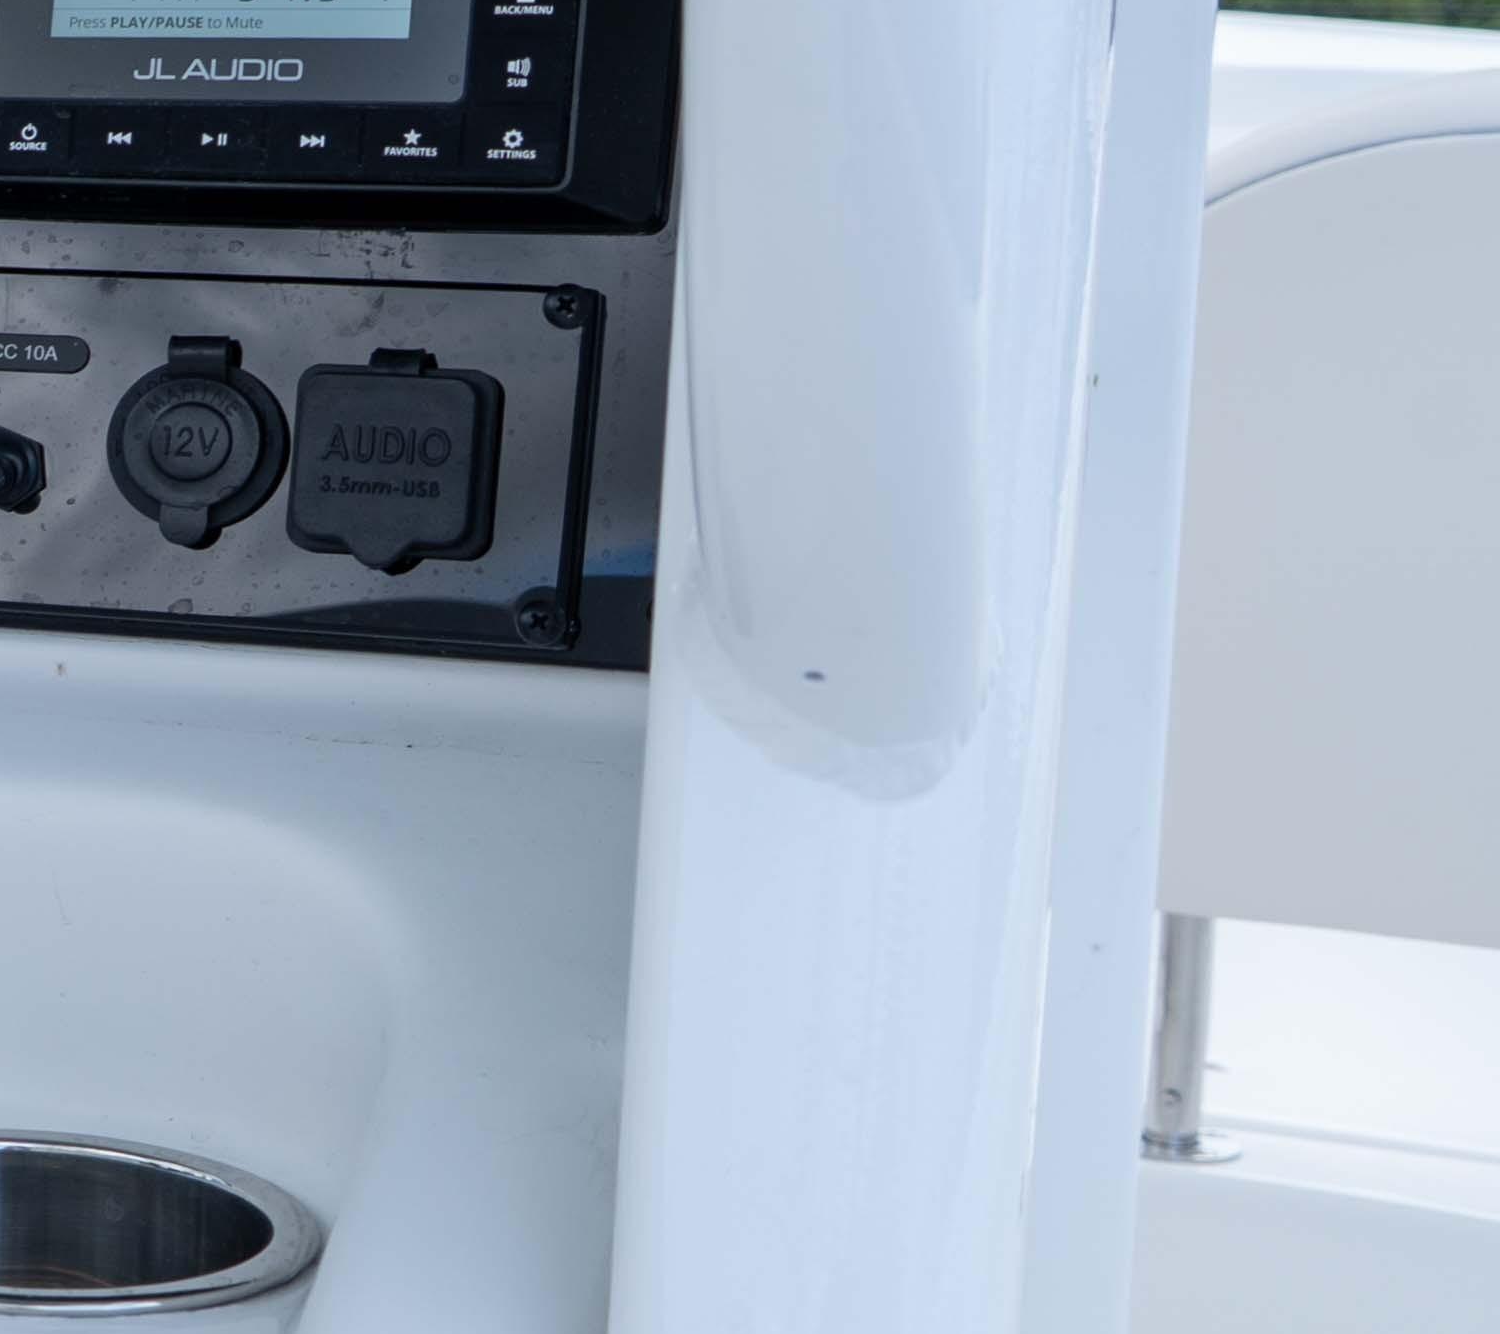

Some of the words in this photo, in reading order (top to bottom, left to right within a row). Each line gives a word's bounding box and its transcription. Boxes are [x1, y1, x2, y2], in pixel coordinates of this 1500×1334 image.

[494, 5, 554, 15] BACK/MENU
[68, 16, 108, 29] Press
[110, 16, 204, 30] PLAY/PAUSE
[208, 17, 222, 29] to
[226, 16, 264, 29] Mute
[133, 58, 176, 80] JL
[180, 58, 304, 82] AUDIO
[9, 141, 47, 151] SOURCE
[384, 146, 438, 157] FAVORITES
[487, 149, 537, 160] SETTINGS
[23, 343, 58, 362] 10A
[163, 425, 220, 458] 12V
[321, 424, 452, 466] AUDIO
[318, 473, 441, 499] 3.5mm-USB
